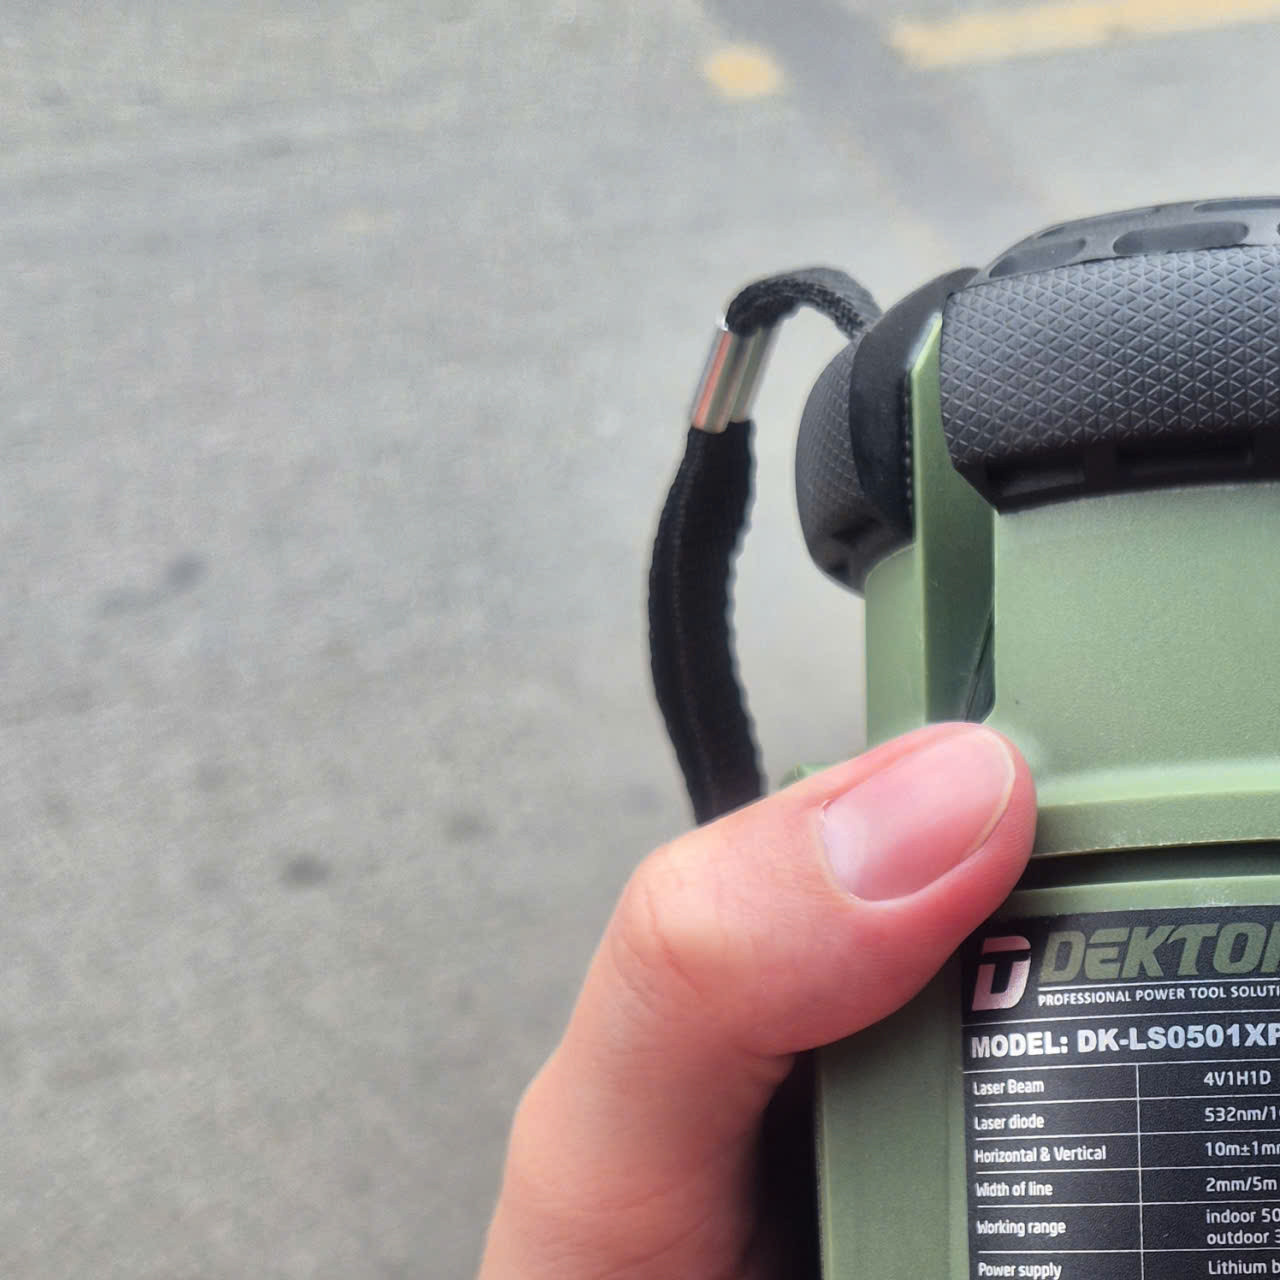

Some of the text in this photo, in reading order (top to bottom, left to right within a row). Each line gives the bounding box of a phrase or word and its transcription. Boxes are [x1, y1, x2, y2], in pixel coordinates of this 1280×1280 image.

[1038, 991, 1132, 1007] PROFESSIONAL
[1136, 987, 1184, 1001] POWER
[1189, 986, 1227, 999] TOOL
[971, 1031, 1069, 1058] MODEL:
[1204, 1070, 1271, 1086] 4V1H1D
[974, 1079, 1044, 1095] Laser Beam
[974, 1114, 1044, 1130] Laser diode
[975, 1146, 1106, 1163] Horizontal & Vertical
[976, 1181, 1052, 1197] Width of line
[1206, 1176, 1278, 1193] 2mm/5m
[1206, 1209, 1256, 1224] indoor
[977, 1220, 1066, 1237] Working range
[1207, 1230, 1269, 1245] outdoor
[978, 1263, 1061, 1280] Power supply
[1208, 1260, 1267, 1275] Lithium
